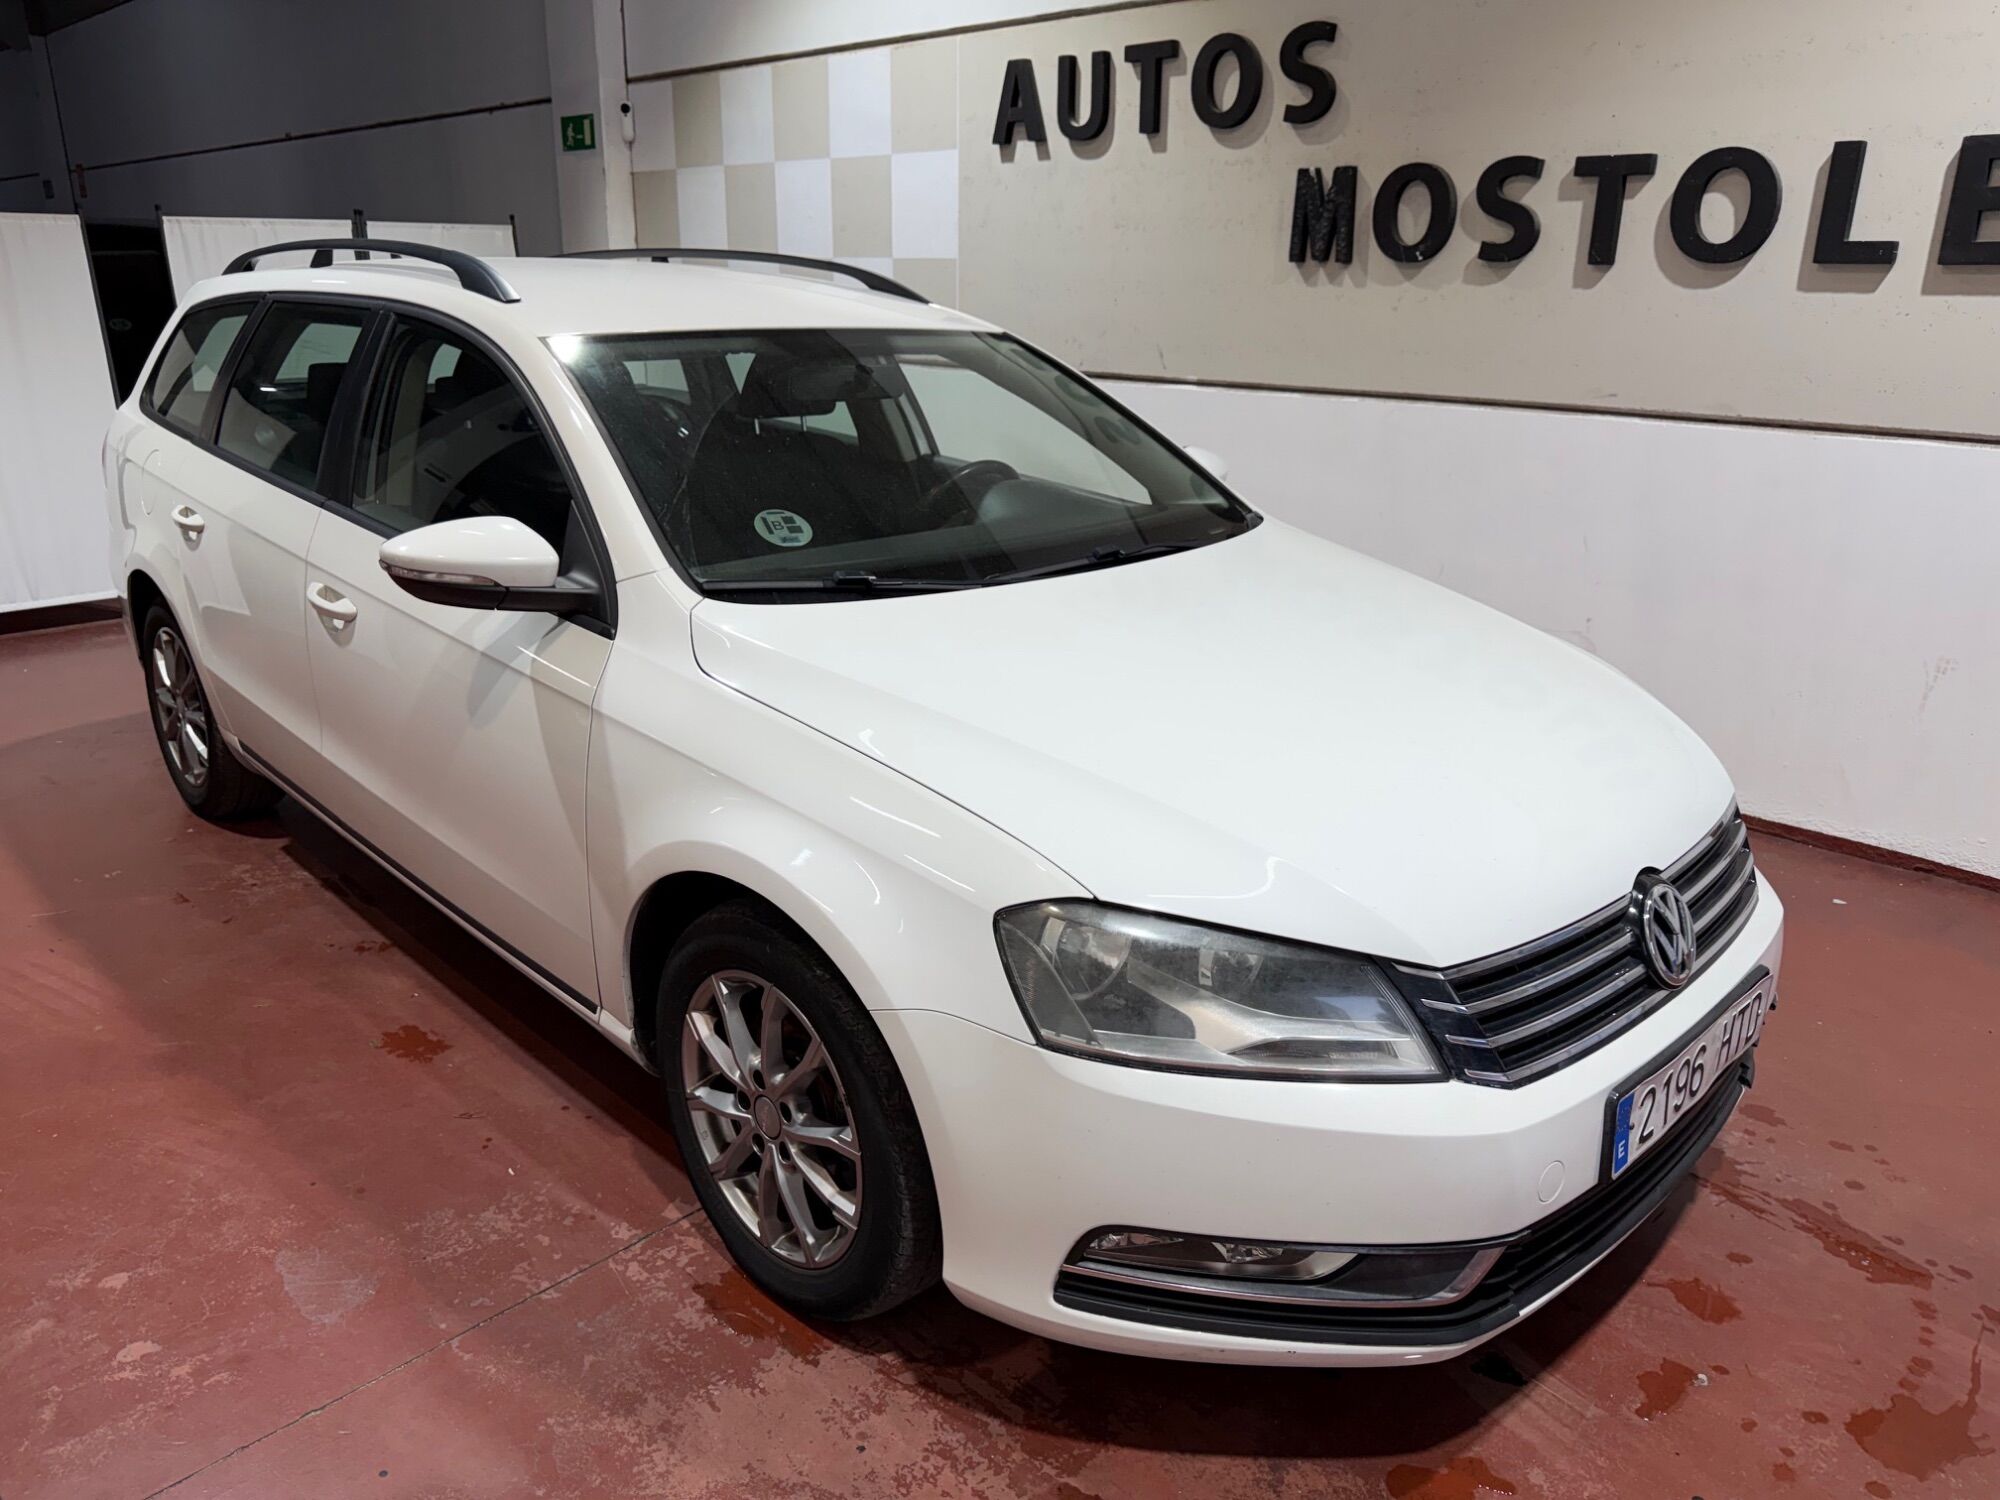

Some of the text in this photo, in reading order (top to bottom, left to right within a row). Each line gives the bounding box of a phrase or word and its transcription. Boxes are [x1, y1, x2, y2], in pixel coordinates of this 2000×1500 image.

[992, 21, 1338, 147] AUTOS
[1637, 991, 1763, 1145] 2196 HTD
[1617, 1139, 1626, 1159] E
